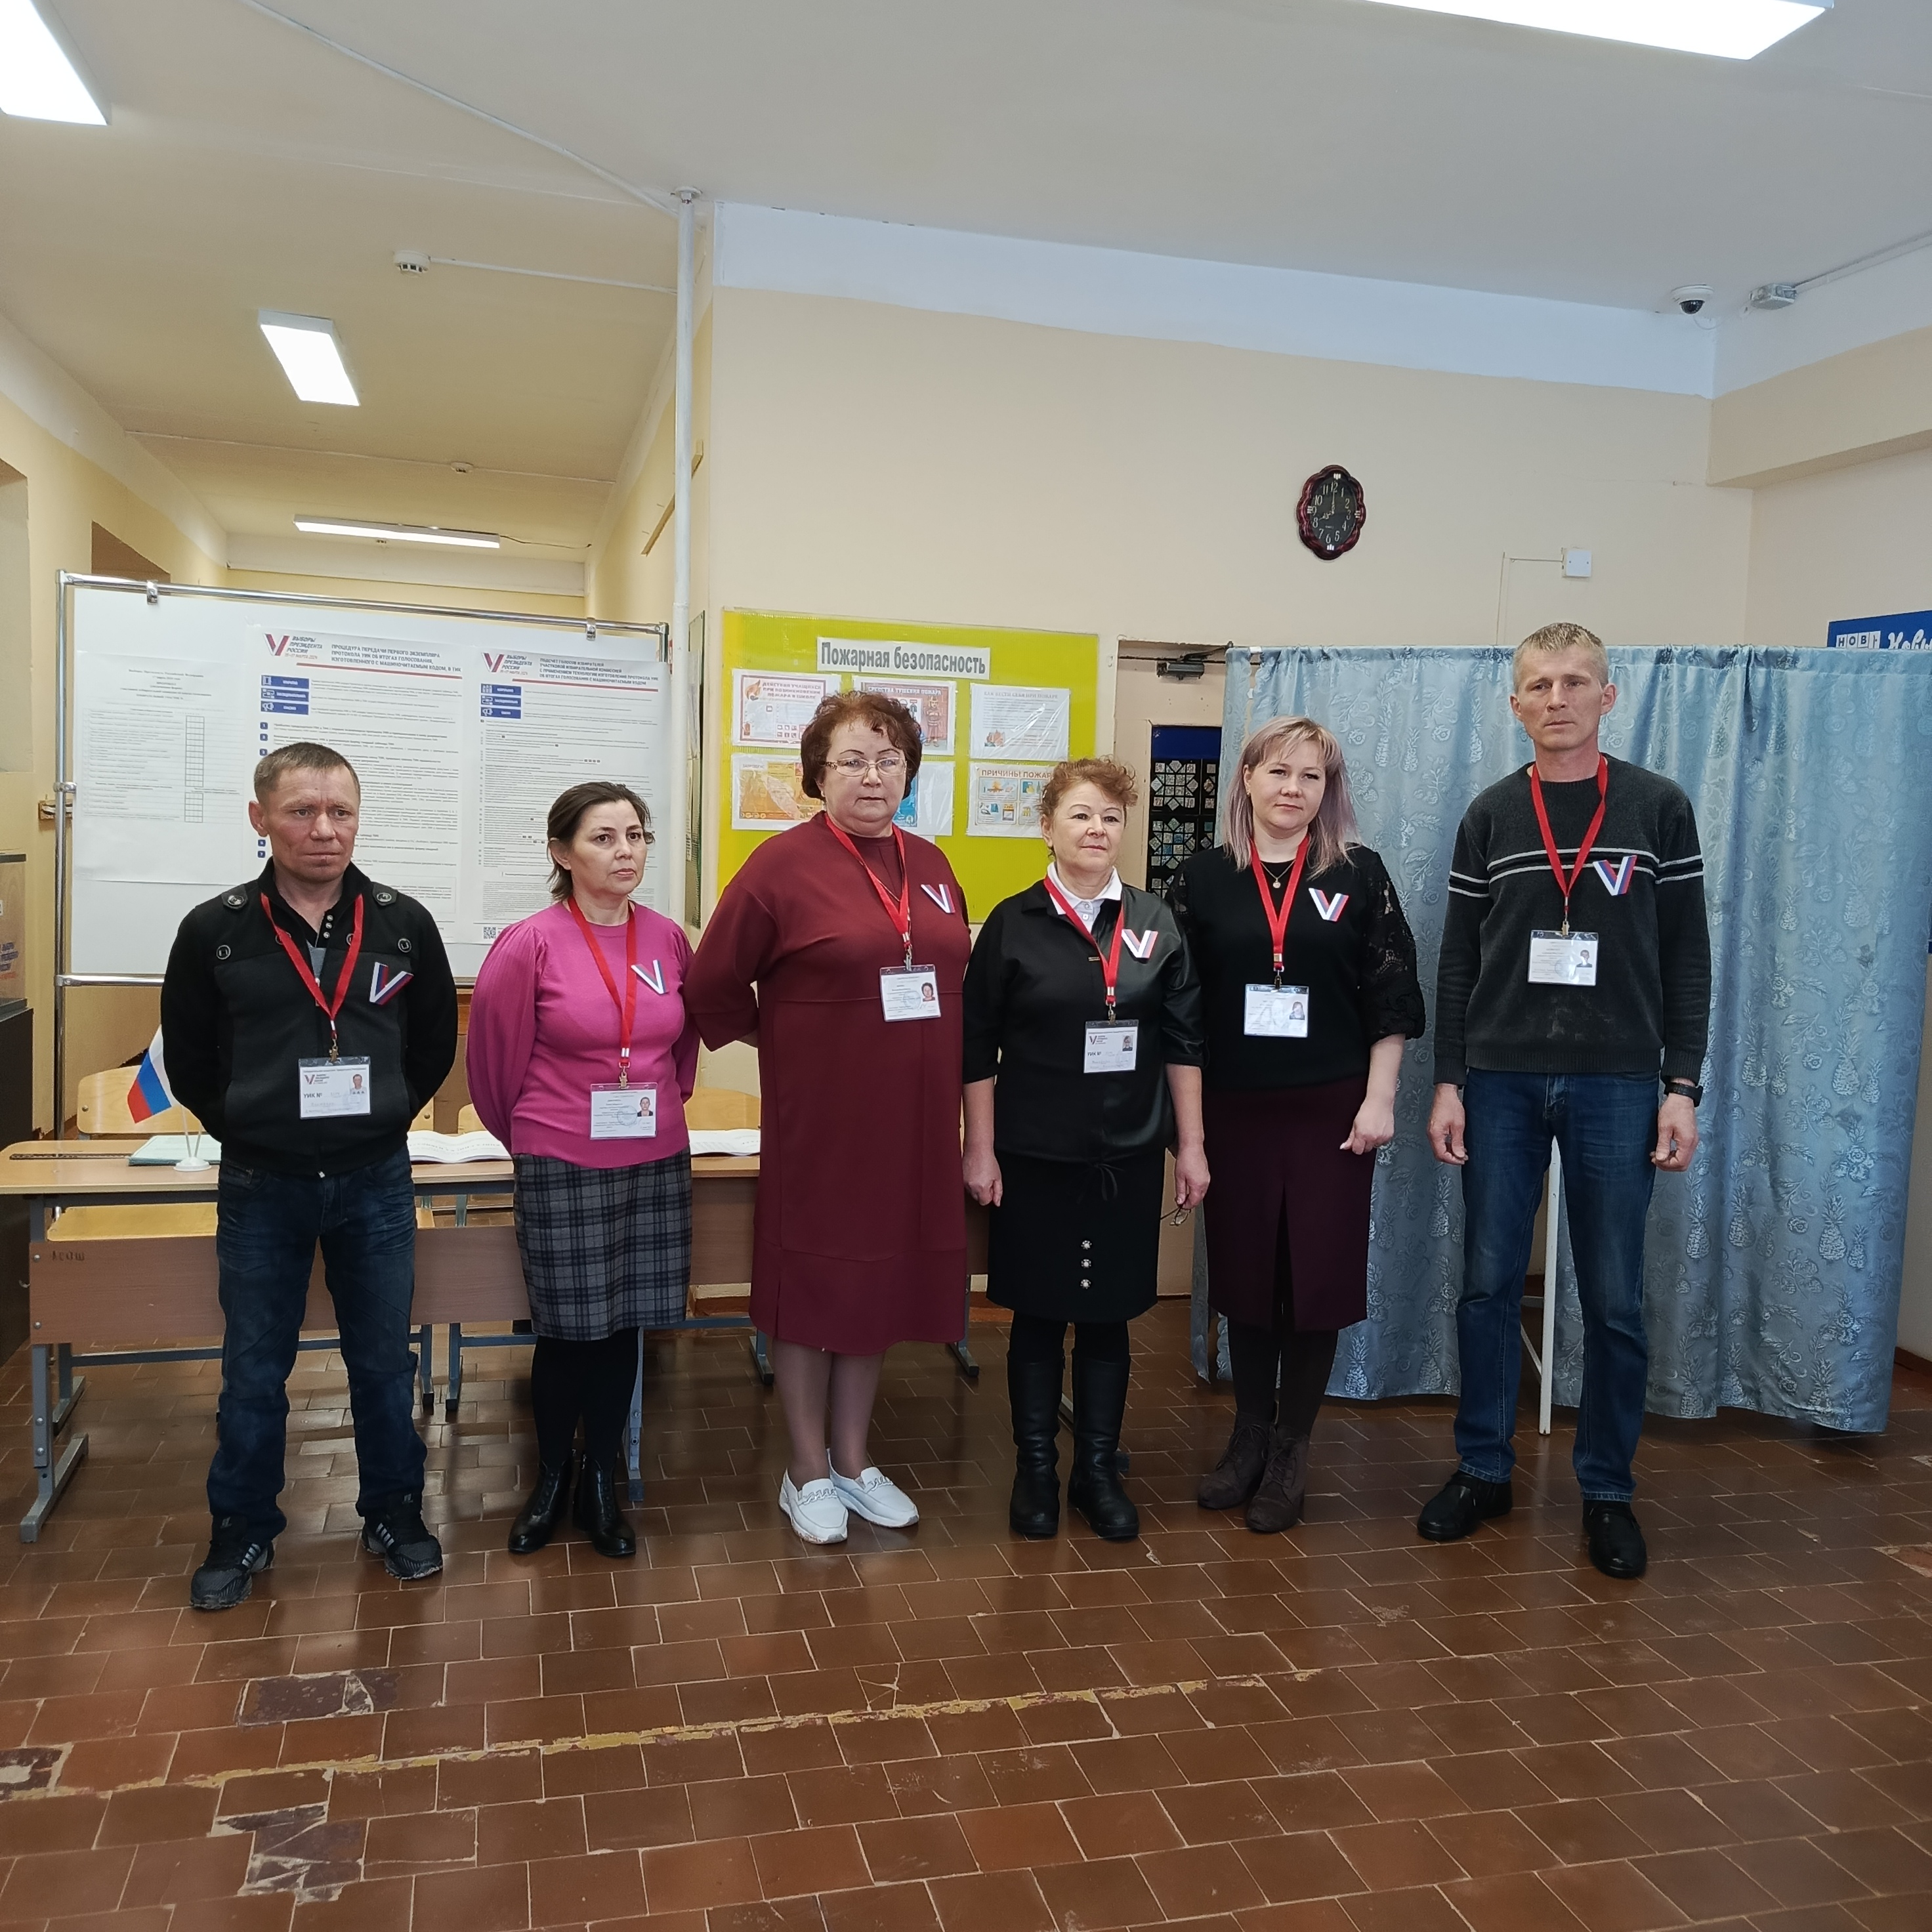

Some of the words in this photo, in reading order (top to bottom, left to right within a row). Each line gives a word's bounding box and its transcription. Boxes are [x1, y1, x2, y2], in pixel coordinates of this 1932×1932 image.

[1323, 484, 1328, 495] 11
[1331, 482, 1338, 492] 12
[1341, 487, 1344, 497] 1
[1315, 495, 1323, 506] 10
[1345, 499, 1349, 509] 2
[1312, 506, 1316, 516] 9
[1346, 509, 1351, 520] 3
[1312, 517, 1318, 528] 8
[1341, 520, 1347, 531] 4
[1319, 528, 1324, 539] 7
[1326, 533, 1331, 543] 6
[1335, 530, 1340, 541] 5
[822, 642, 890, 672] Пожарная
[894, 646, 986, 675] безопасность
